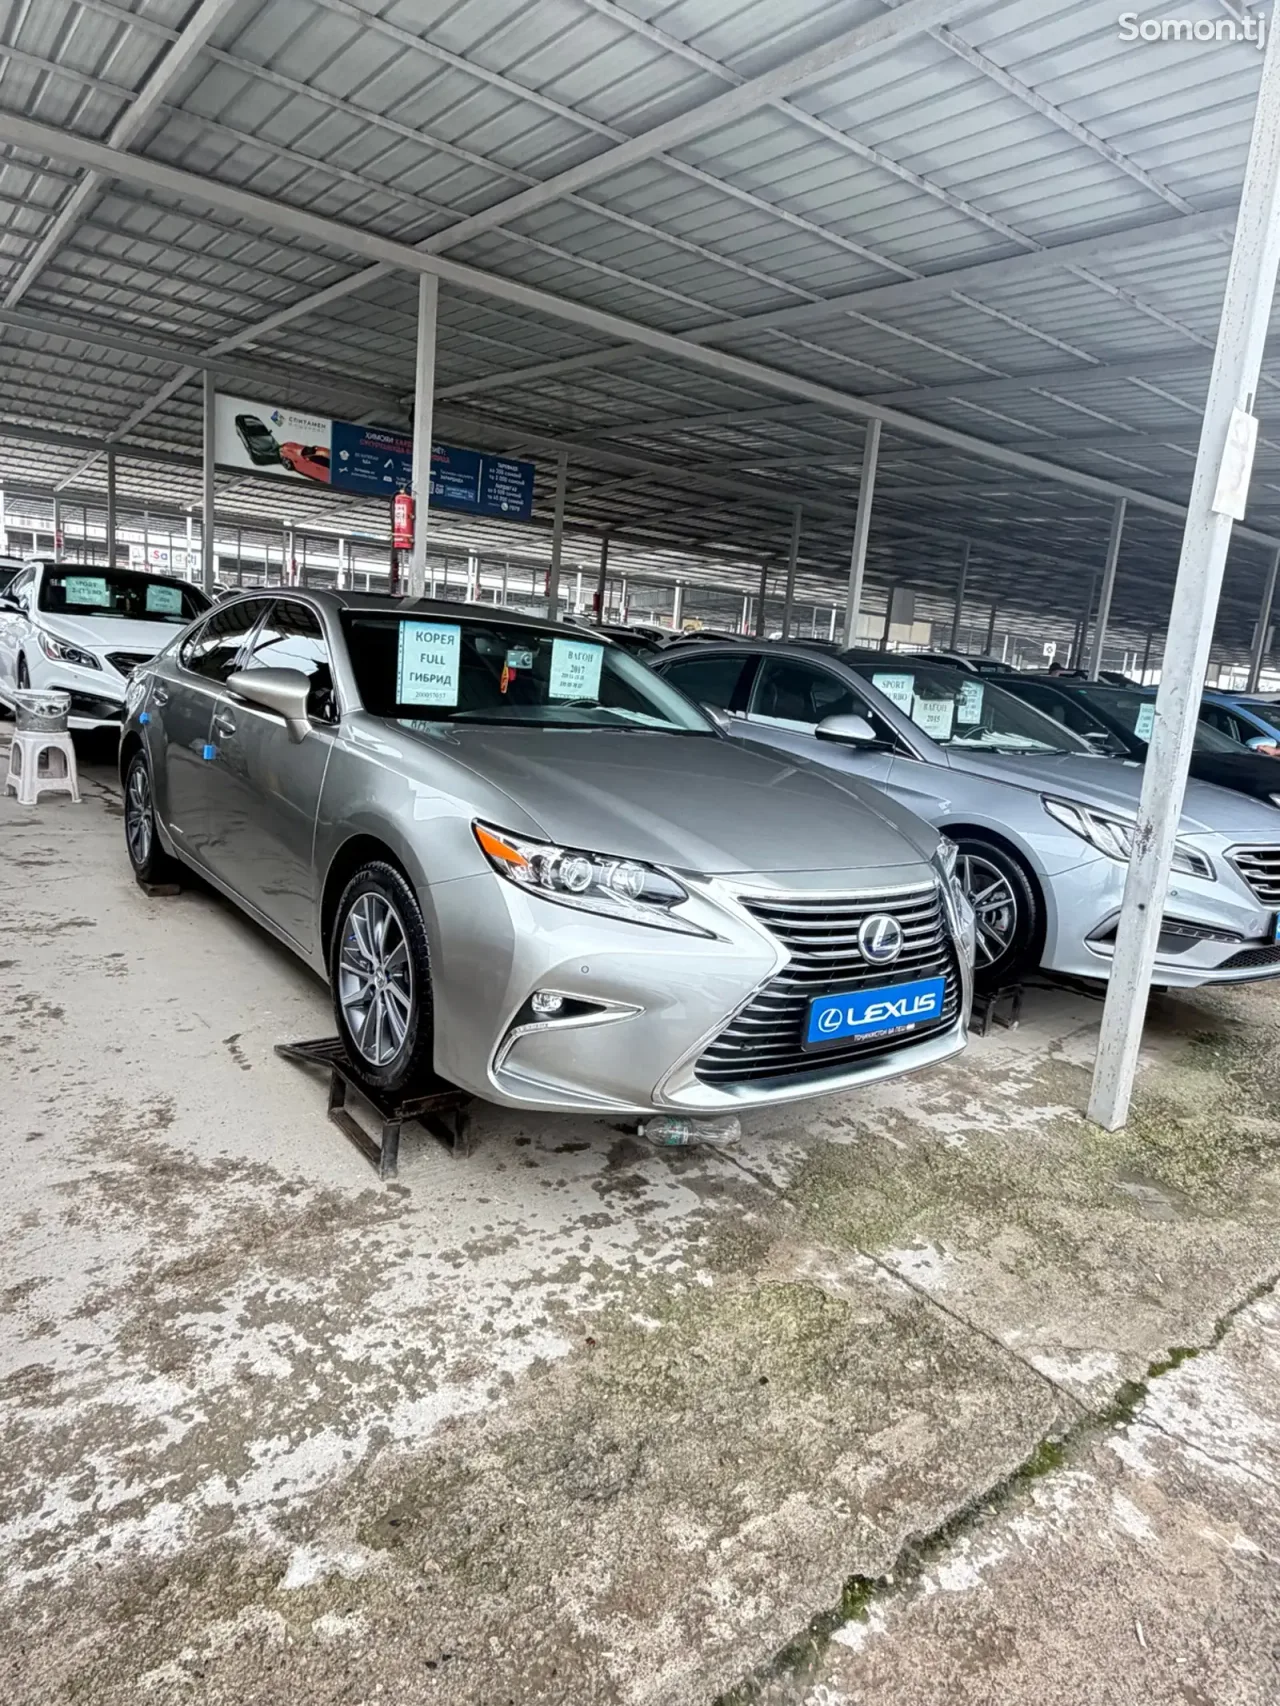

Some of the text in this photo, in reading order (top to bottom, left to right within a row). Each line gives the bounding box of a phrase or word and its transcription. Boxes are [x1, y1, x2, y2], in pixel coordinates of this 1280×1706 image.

[288, 416, 326, 429] СПИТАМЕН
[415, 630, 455, 645] КОРЕЯ
[420, 653, 446, 665] FULL
[568, 650, 594, 662] ВАГОН
[570, 664, 585, 674] 2017
[409, 671, 452, 687] ГИБРИД
[882, 680, 905, 689] SPORT
[847, 993, 936, 1026] LEXUS
